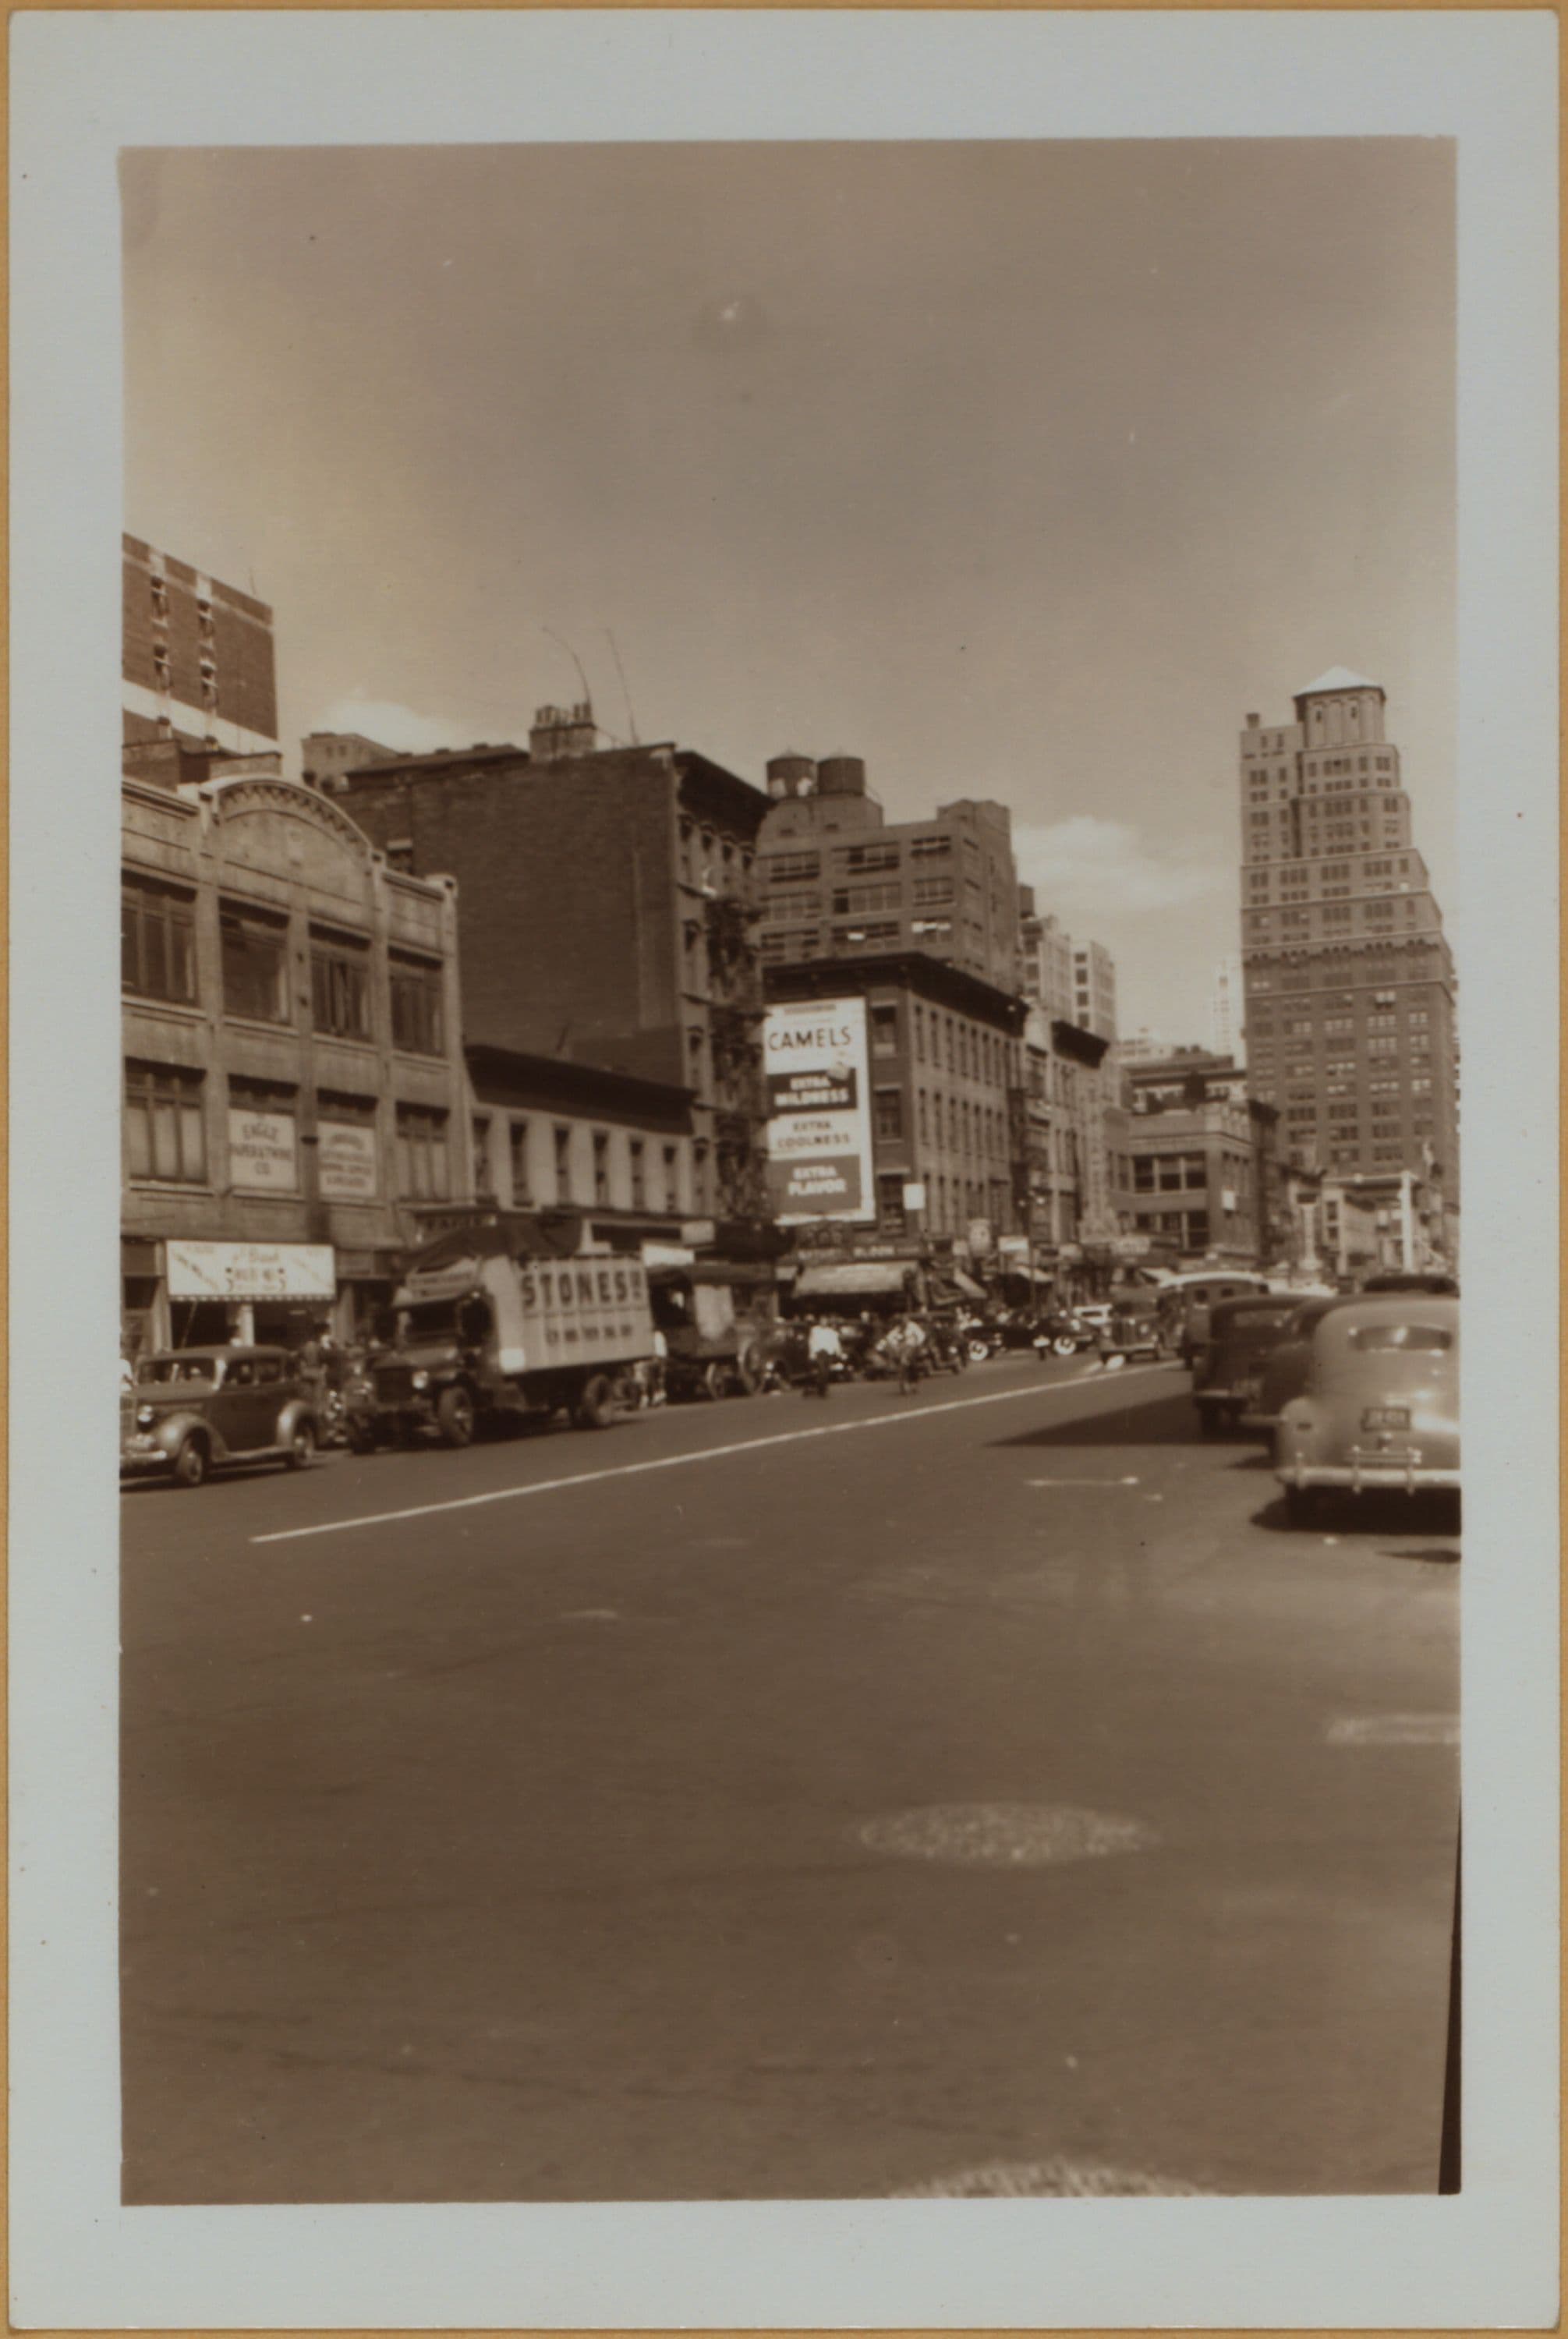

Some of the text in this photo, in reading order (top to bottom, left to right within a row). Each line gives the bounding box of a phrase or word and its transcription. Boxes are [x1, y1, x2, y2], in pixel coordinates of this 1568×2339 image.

[769, 1026, 851, 1052] CAMELS
[790, 1075, 832, 1091] EXTRA
[774, 1088, 849, 1106] MILDNESS
[793, 1120, 832, 1132] EXTRA
[777, 1133, 850, 1150] COOLNESS
[793, 1165, 837, 1181] EXTRA
[788, 1178, 848, 1197] FLAVOR
[522, 1272, 628, 1308] STONES
